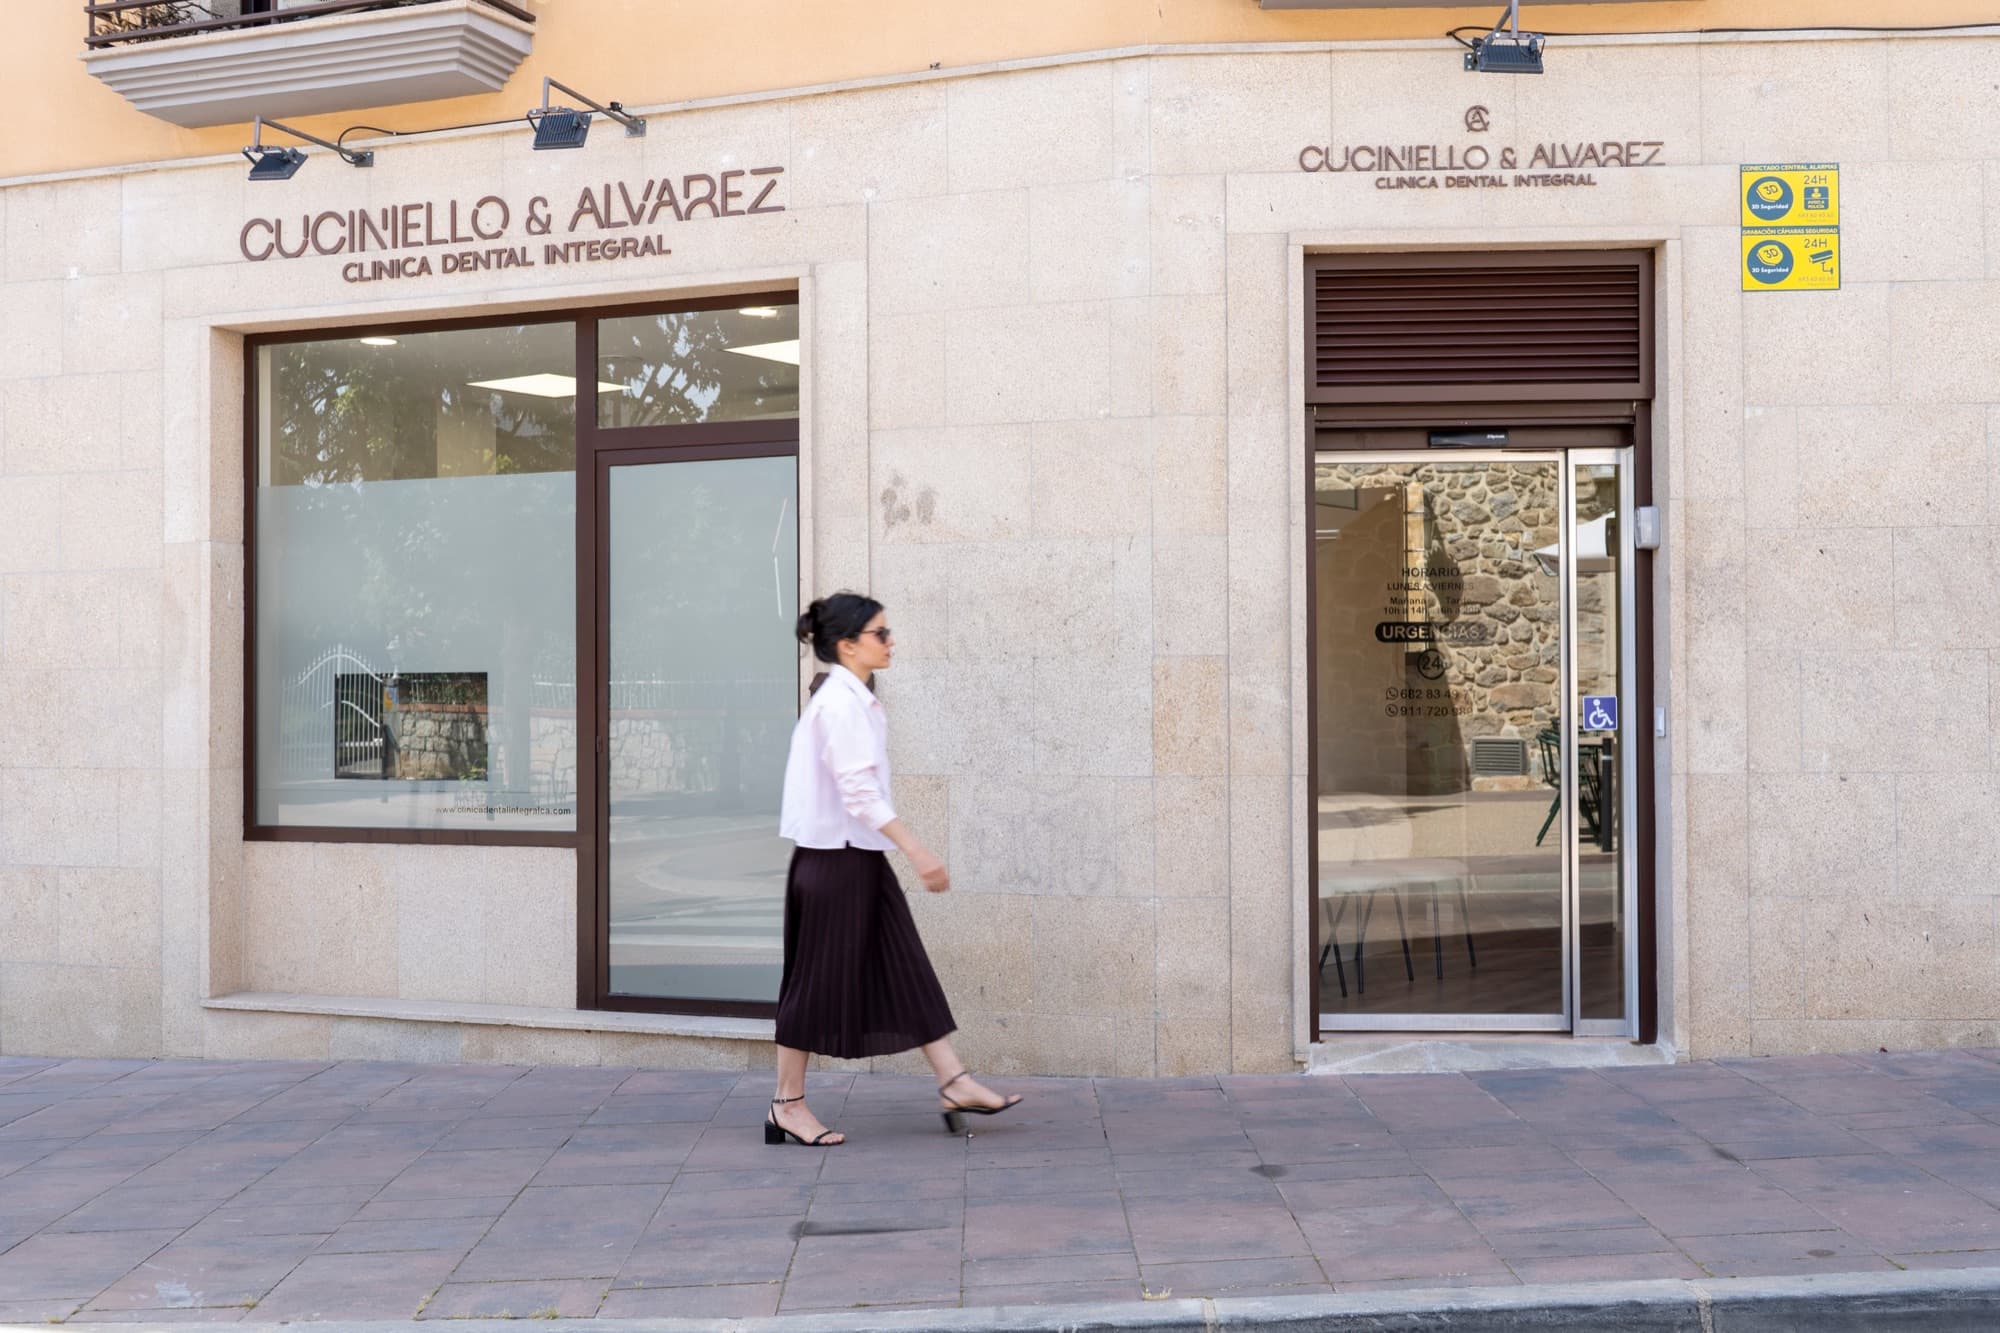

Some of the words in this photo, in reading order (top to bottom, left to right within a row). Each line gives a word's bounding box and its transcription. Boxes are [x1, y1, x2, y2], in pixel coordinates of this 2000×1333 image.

[1299, 145, 1490, 172] CUCINIELLO
[1500, 147, 1518, 170] &
[1529, 141, 1666, 168] ALVAREZ
[1375, 175, 1439, 190] CLINICA
[1445, 174, 1508, 189] DENTAL
[1514, 173, 1597, 188] INTEGRAL
[1803, 175, 1827, 184] 24H
[1763, 184, 1778, 195] 3D
[239, 195, 509, 261] CUCINIELLO
[525, 196, 552, 235] &
[568, 166, 786, 233] ALVAREZ
[1803, 238, 1828, 248] 24H
[341, 254, 433, 283] CLINICA
[441, 246, 534, 274] DENTAL
[543, 234, 672, 266] INTEGRAL
[1763, 248, 1779, 259] 3D
[1401, 568, 1460, 577] HORARIO
[1386, 583, 1420, 591] LUNES
[1432, 582, 1474, 591] VIERNES
[1382, 625, 1480, 640] URGENCIAS
[1400, 689, 1423, 700] 682
[1426, 689, 1441, 699] 83
[1400, 706, 1422, 717] 911
[1427, 706, 1448, 717] 720
